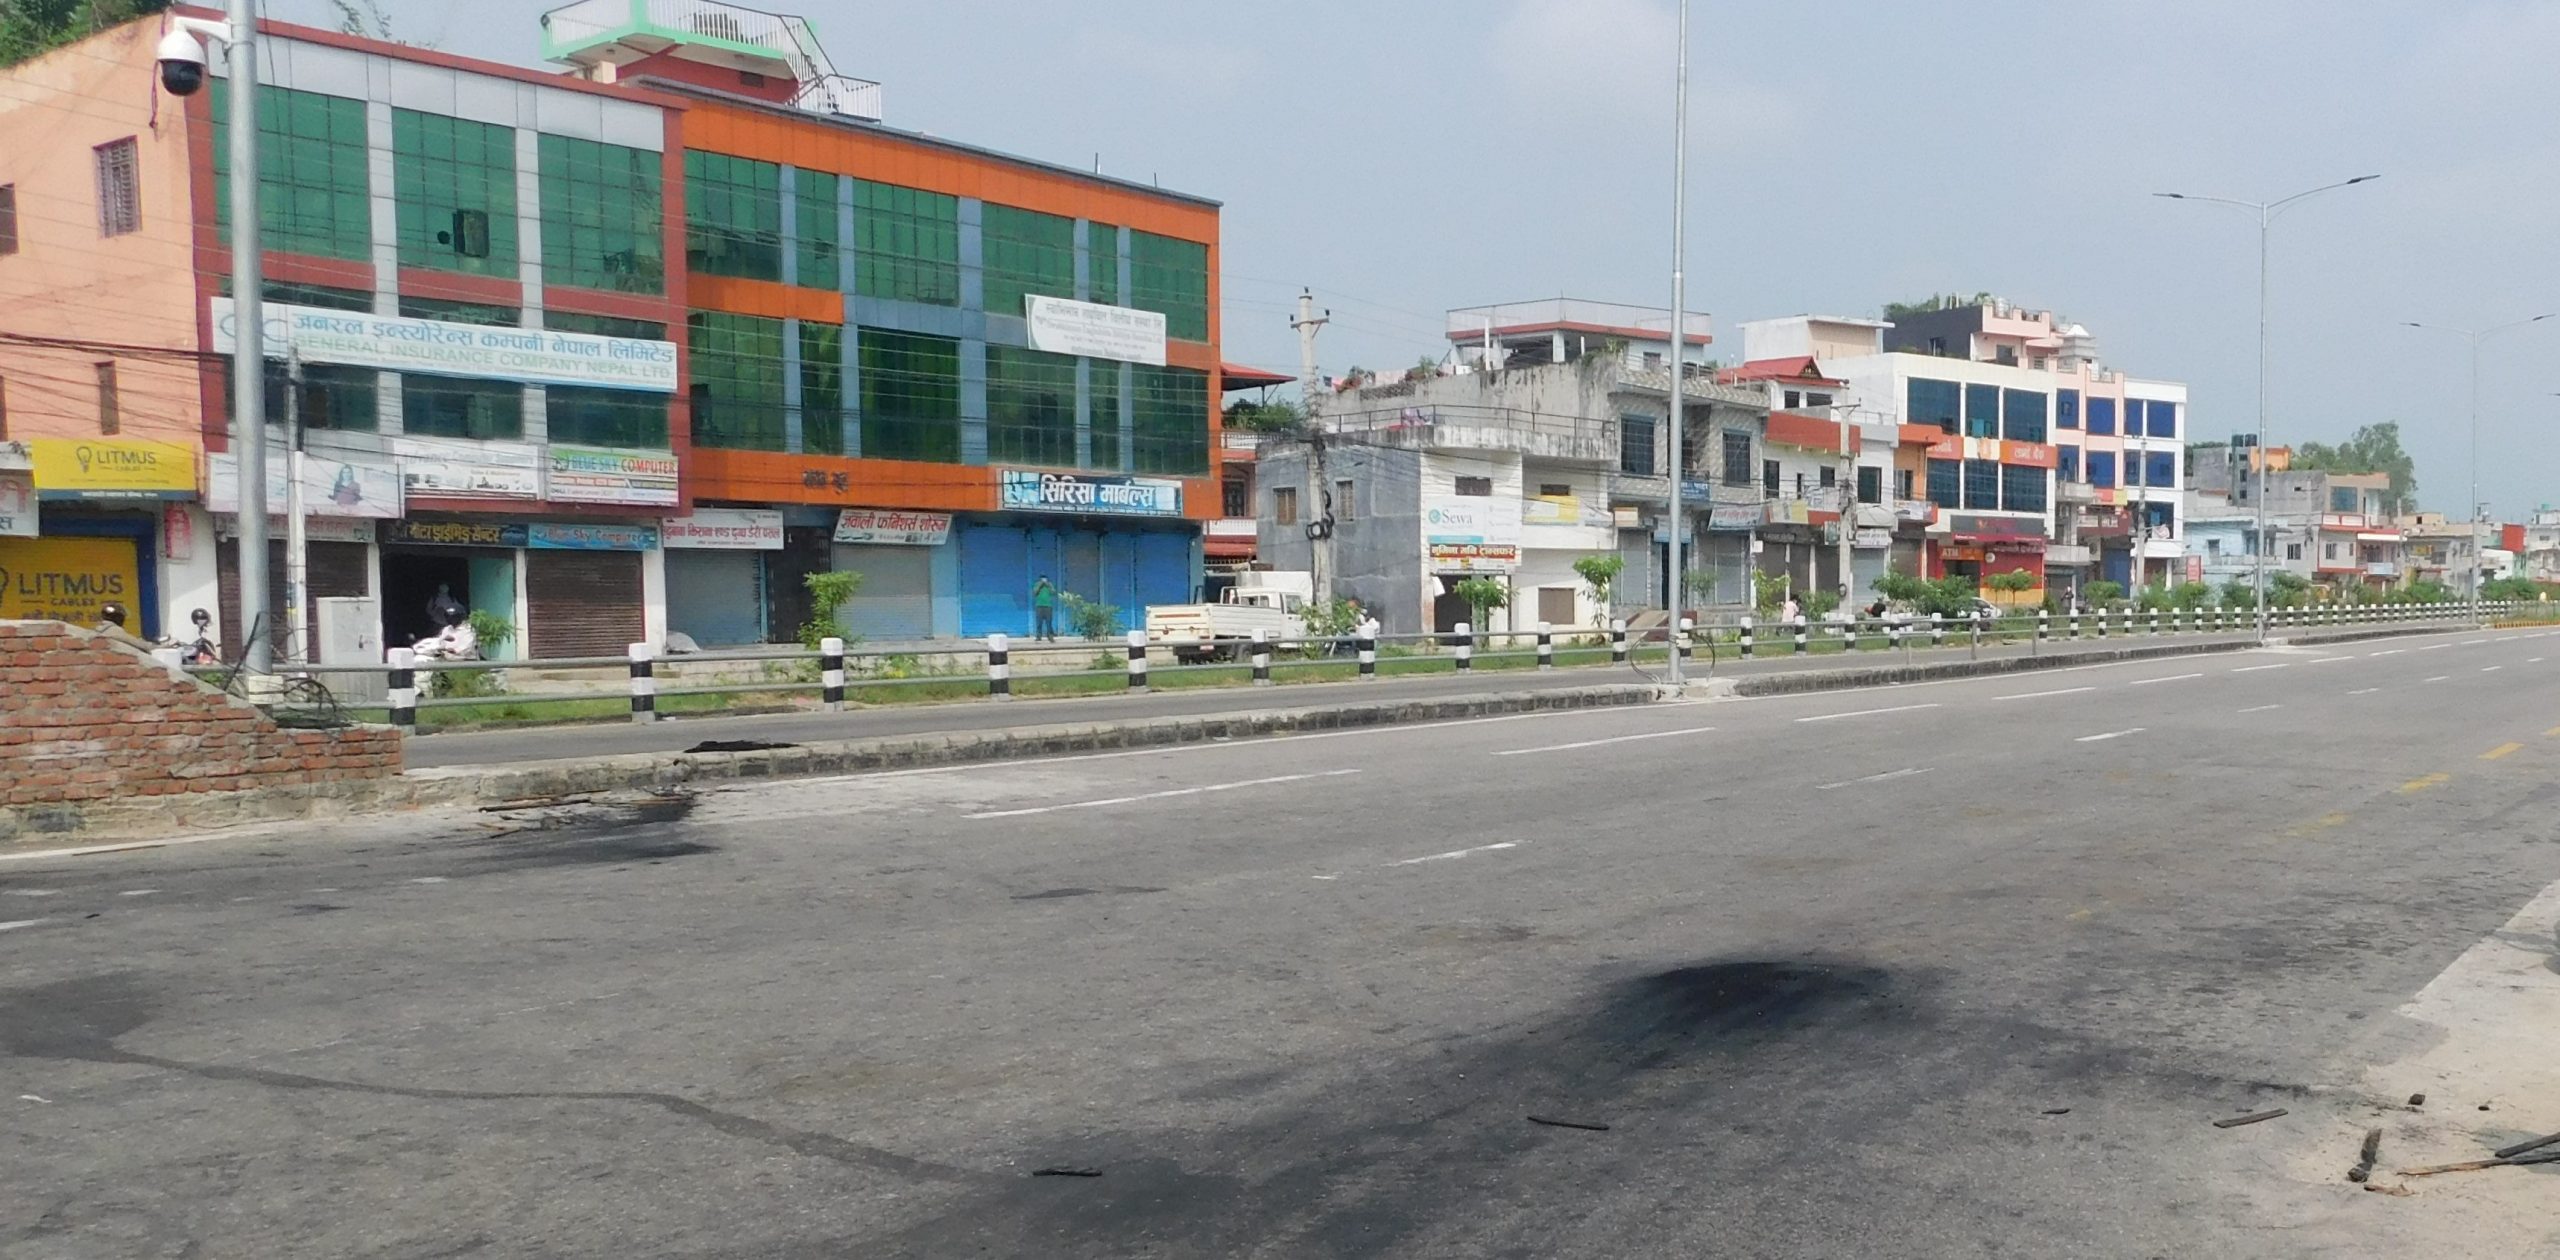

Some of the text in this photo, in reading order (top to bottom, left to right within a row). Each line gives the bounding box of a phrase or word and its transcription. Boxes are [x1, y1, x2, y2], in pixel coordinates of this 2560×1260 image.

[293, 313, 363, 334] जनरल
[480, 331, 543, 352] कम्पनी
[551, 335, 600, 358] नेपाल
[608, 339, 673, 363] लिमिटेड
[294, 336, 384, 355] GENERAL
[390, 344, 492, 364] INSURANCE
[499, 352, 581, 372] COMPANY
[586, 360, 636, 376] NEPAL
[97, 450, 157, 464] LITMUS
[571, 456, 676, 474] BLUE SKY COMPUTER
[1040, 473, 1097, 504] सिरिसा
[1442, 509, 1473, 524] Sewa
[18, 573, 124, 595] LITMUS
[51, 597, 96, 606] CABLES
